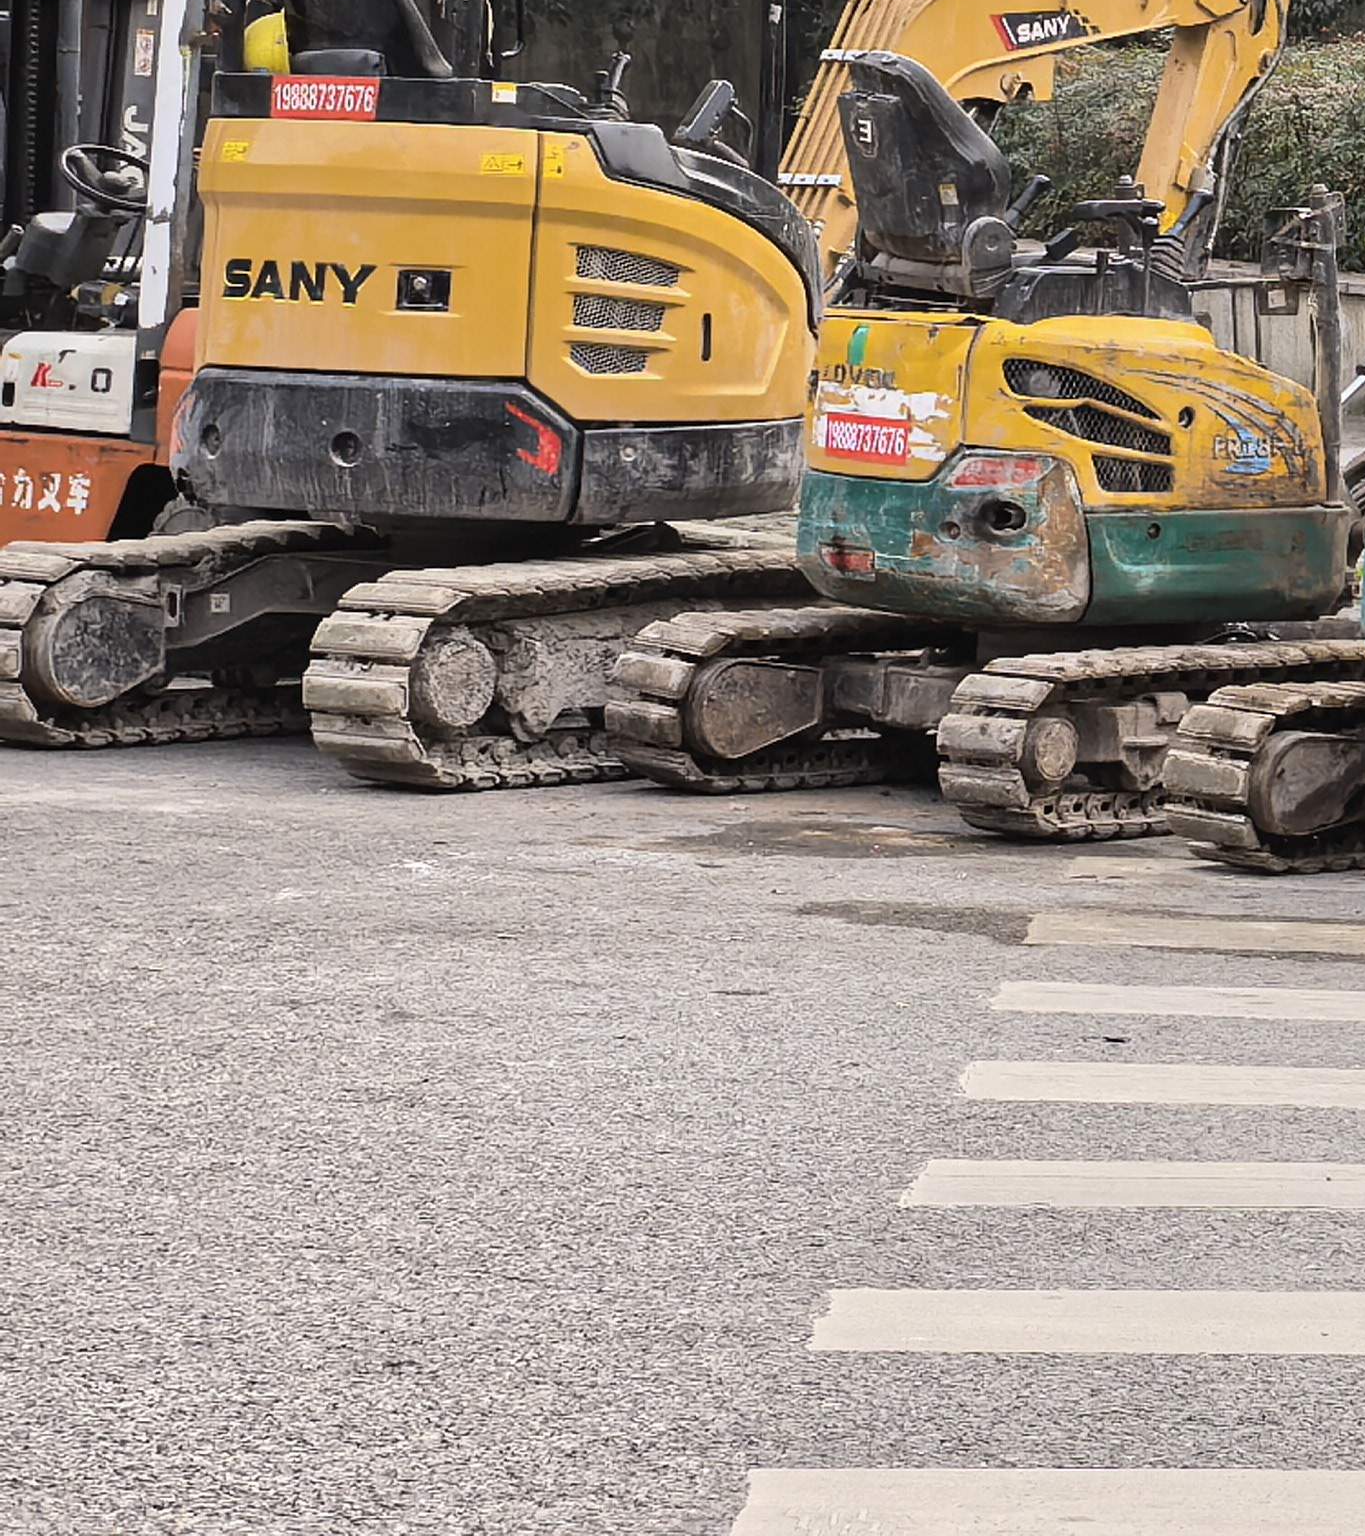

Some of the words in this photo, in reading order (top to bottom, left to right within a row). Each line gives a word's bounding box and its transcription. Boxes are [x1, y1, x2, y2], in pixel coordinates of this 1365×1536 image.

[1017, 14, 1071, 43] SANY
[274, 82, 376, 112] 19888737676
[222, 258, 377, 307] SANY
[828, 420, 907, 455] 19888737676
